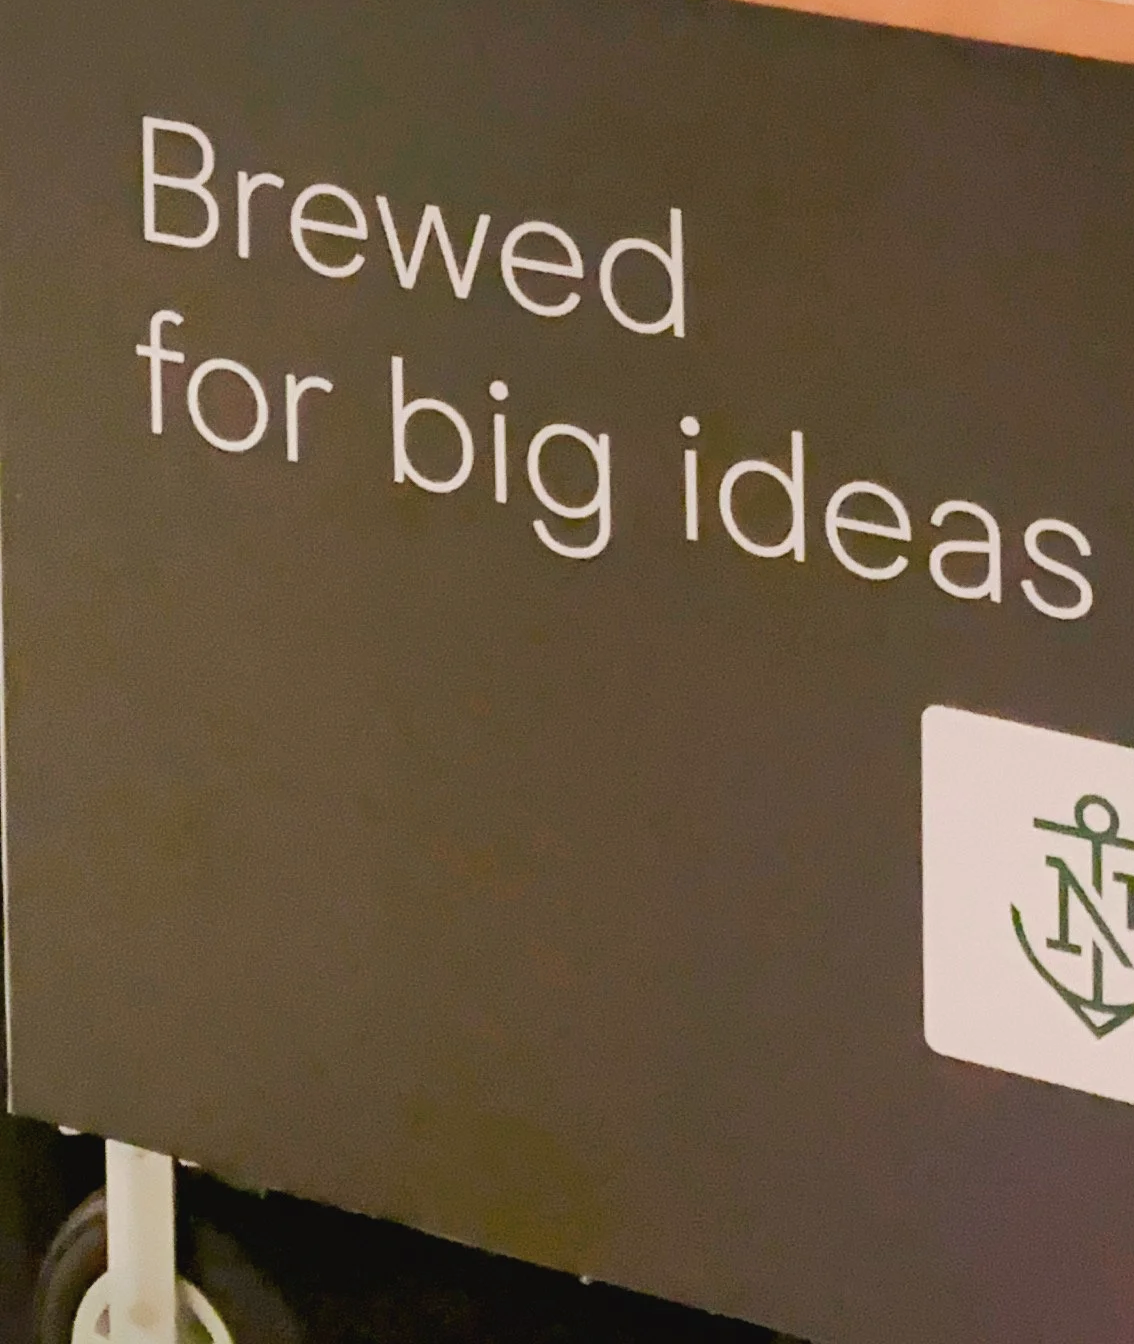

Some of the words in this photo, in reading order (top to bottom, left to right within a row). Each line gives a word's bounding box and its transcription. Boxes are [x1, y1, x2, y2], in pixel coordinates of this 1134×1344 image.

[141, 115, 687, 339] Brewed
[136, 309, 333, 463] for
[391, 355, 611, 560] big
[679, 414, 1094, 621] ideas
